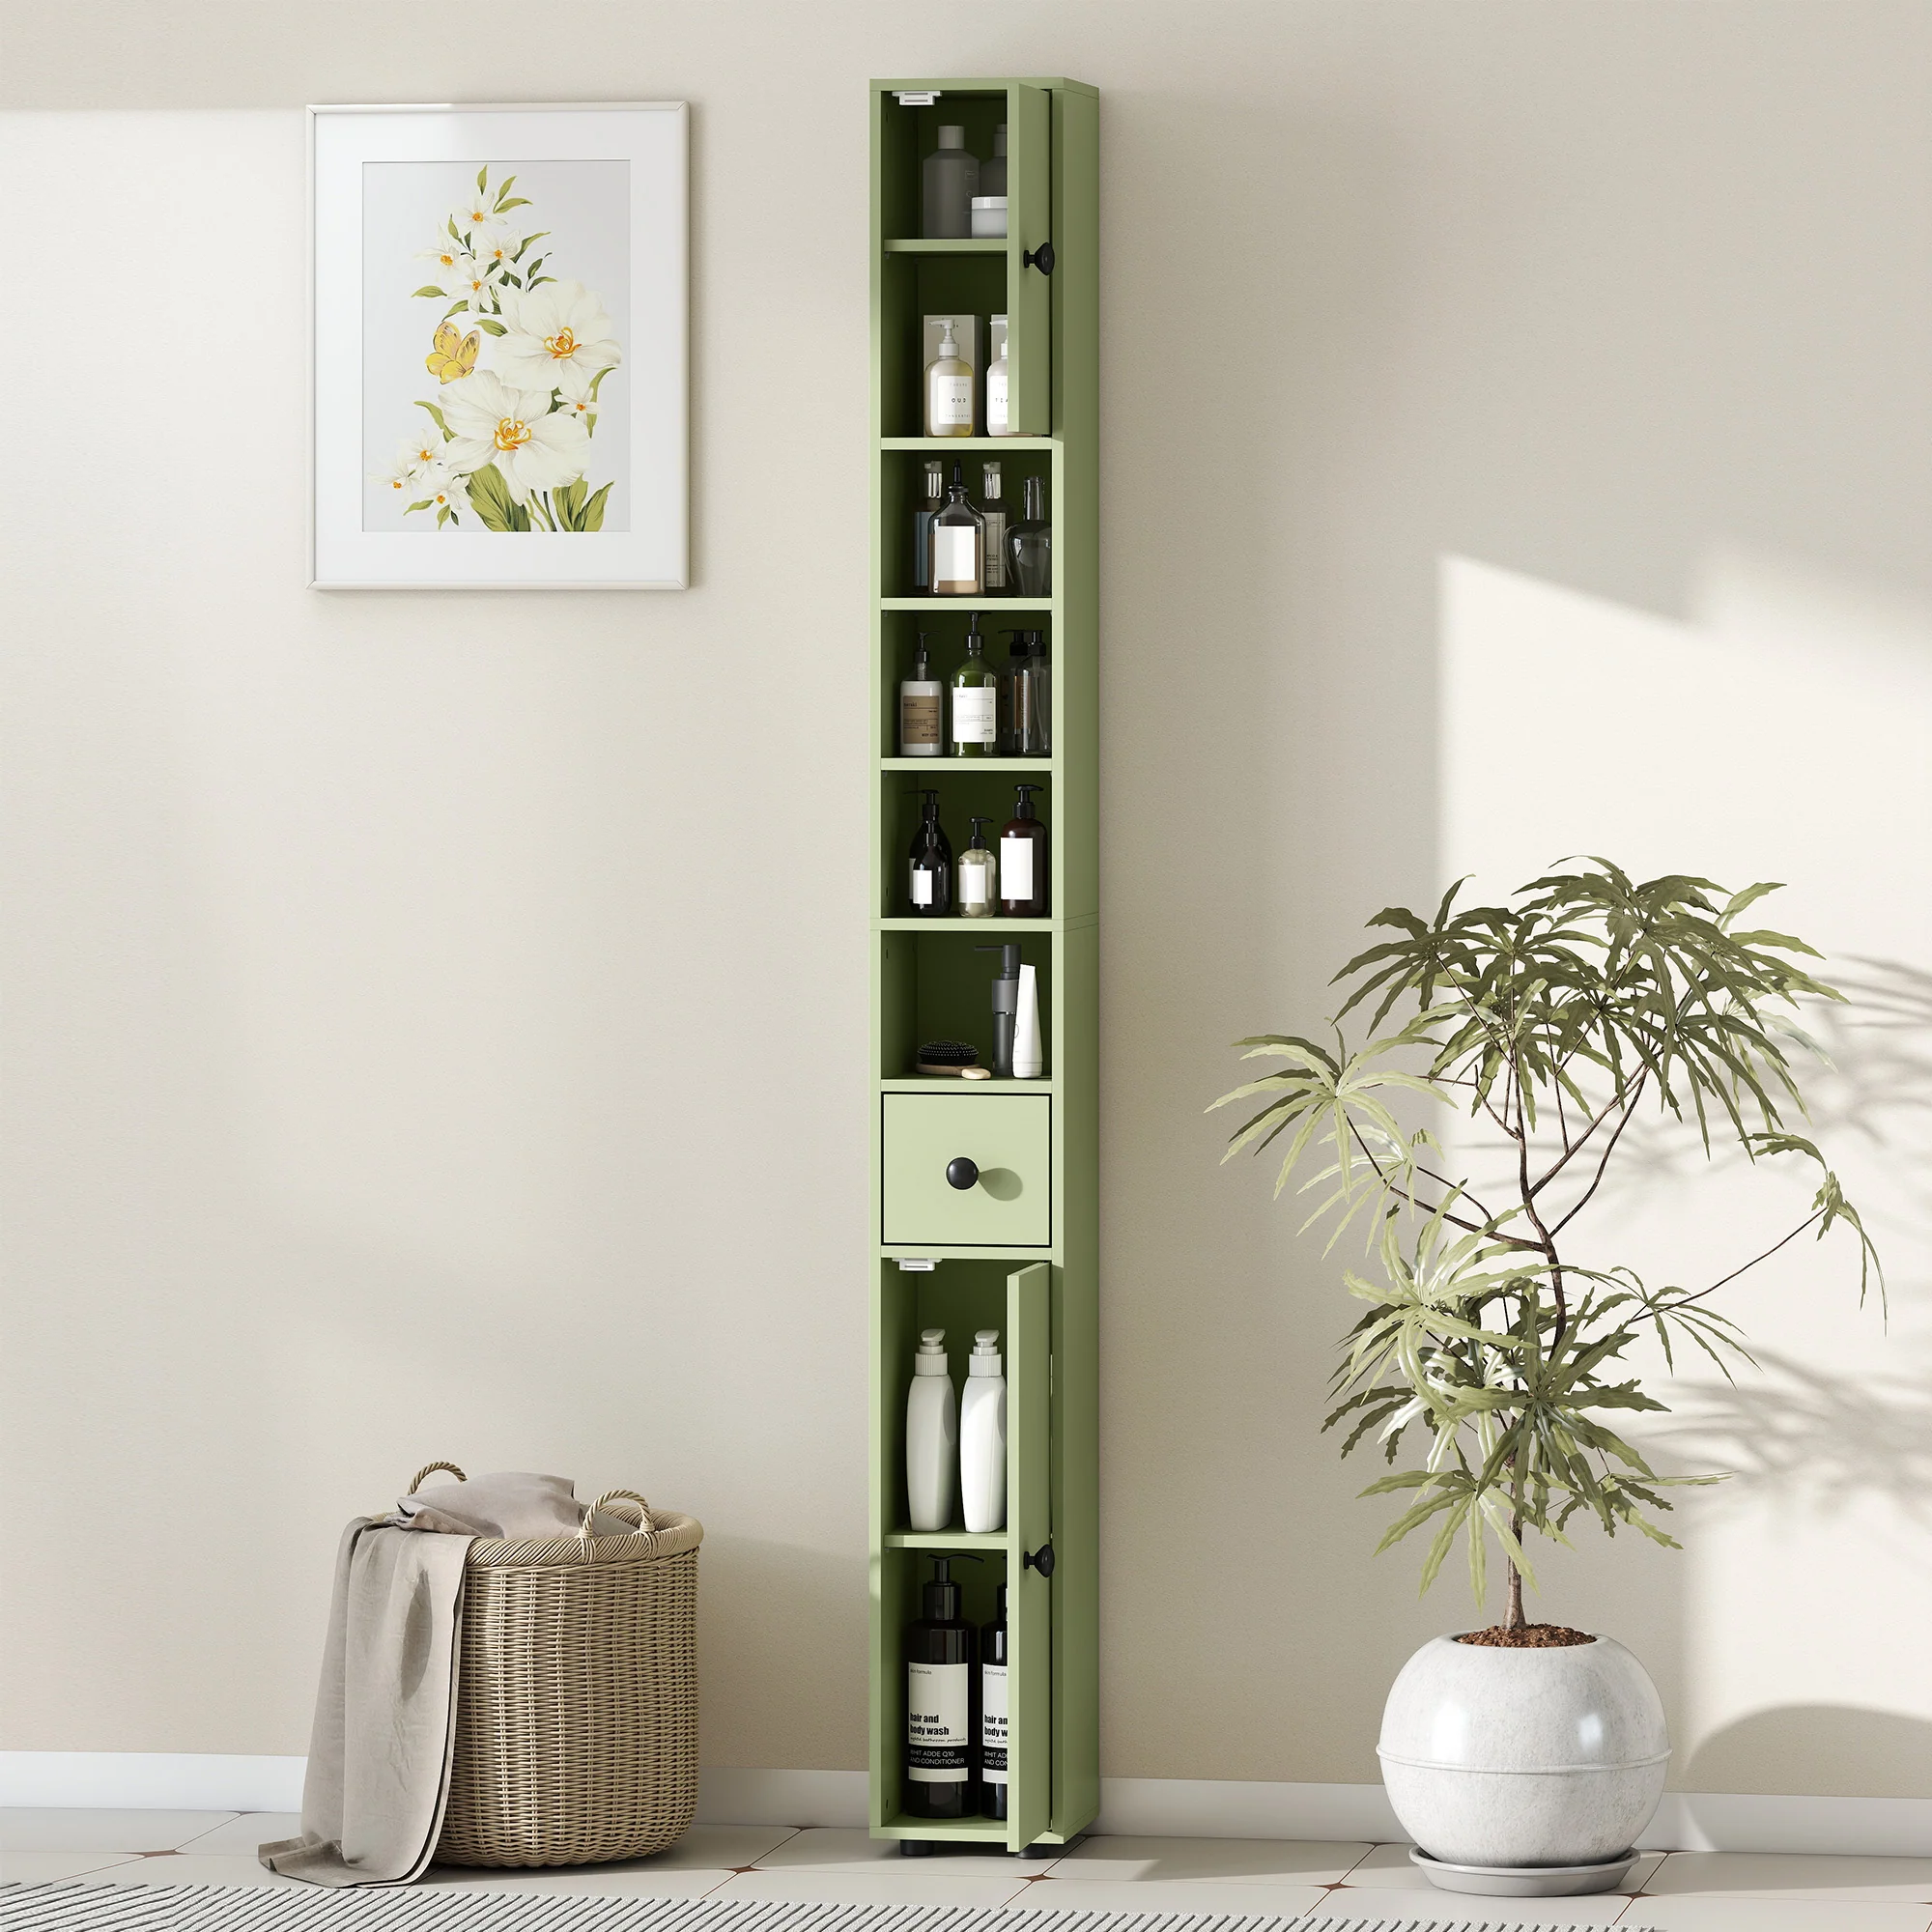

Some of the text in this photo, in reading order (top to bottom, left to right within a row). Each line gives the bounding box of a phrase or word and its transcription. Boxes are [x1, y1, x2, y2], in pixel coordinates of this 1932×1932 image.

[910, 1713, 939, 1723] hair and
[984, 1714, 1008, 1725] hair an
[910, 1724, 950, 1735] body wash
[984, 1726, 1000, 1737] body
